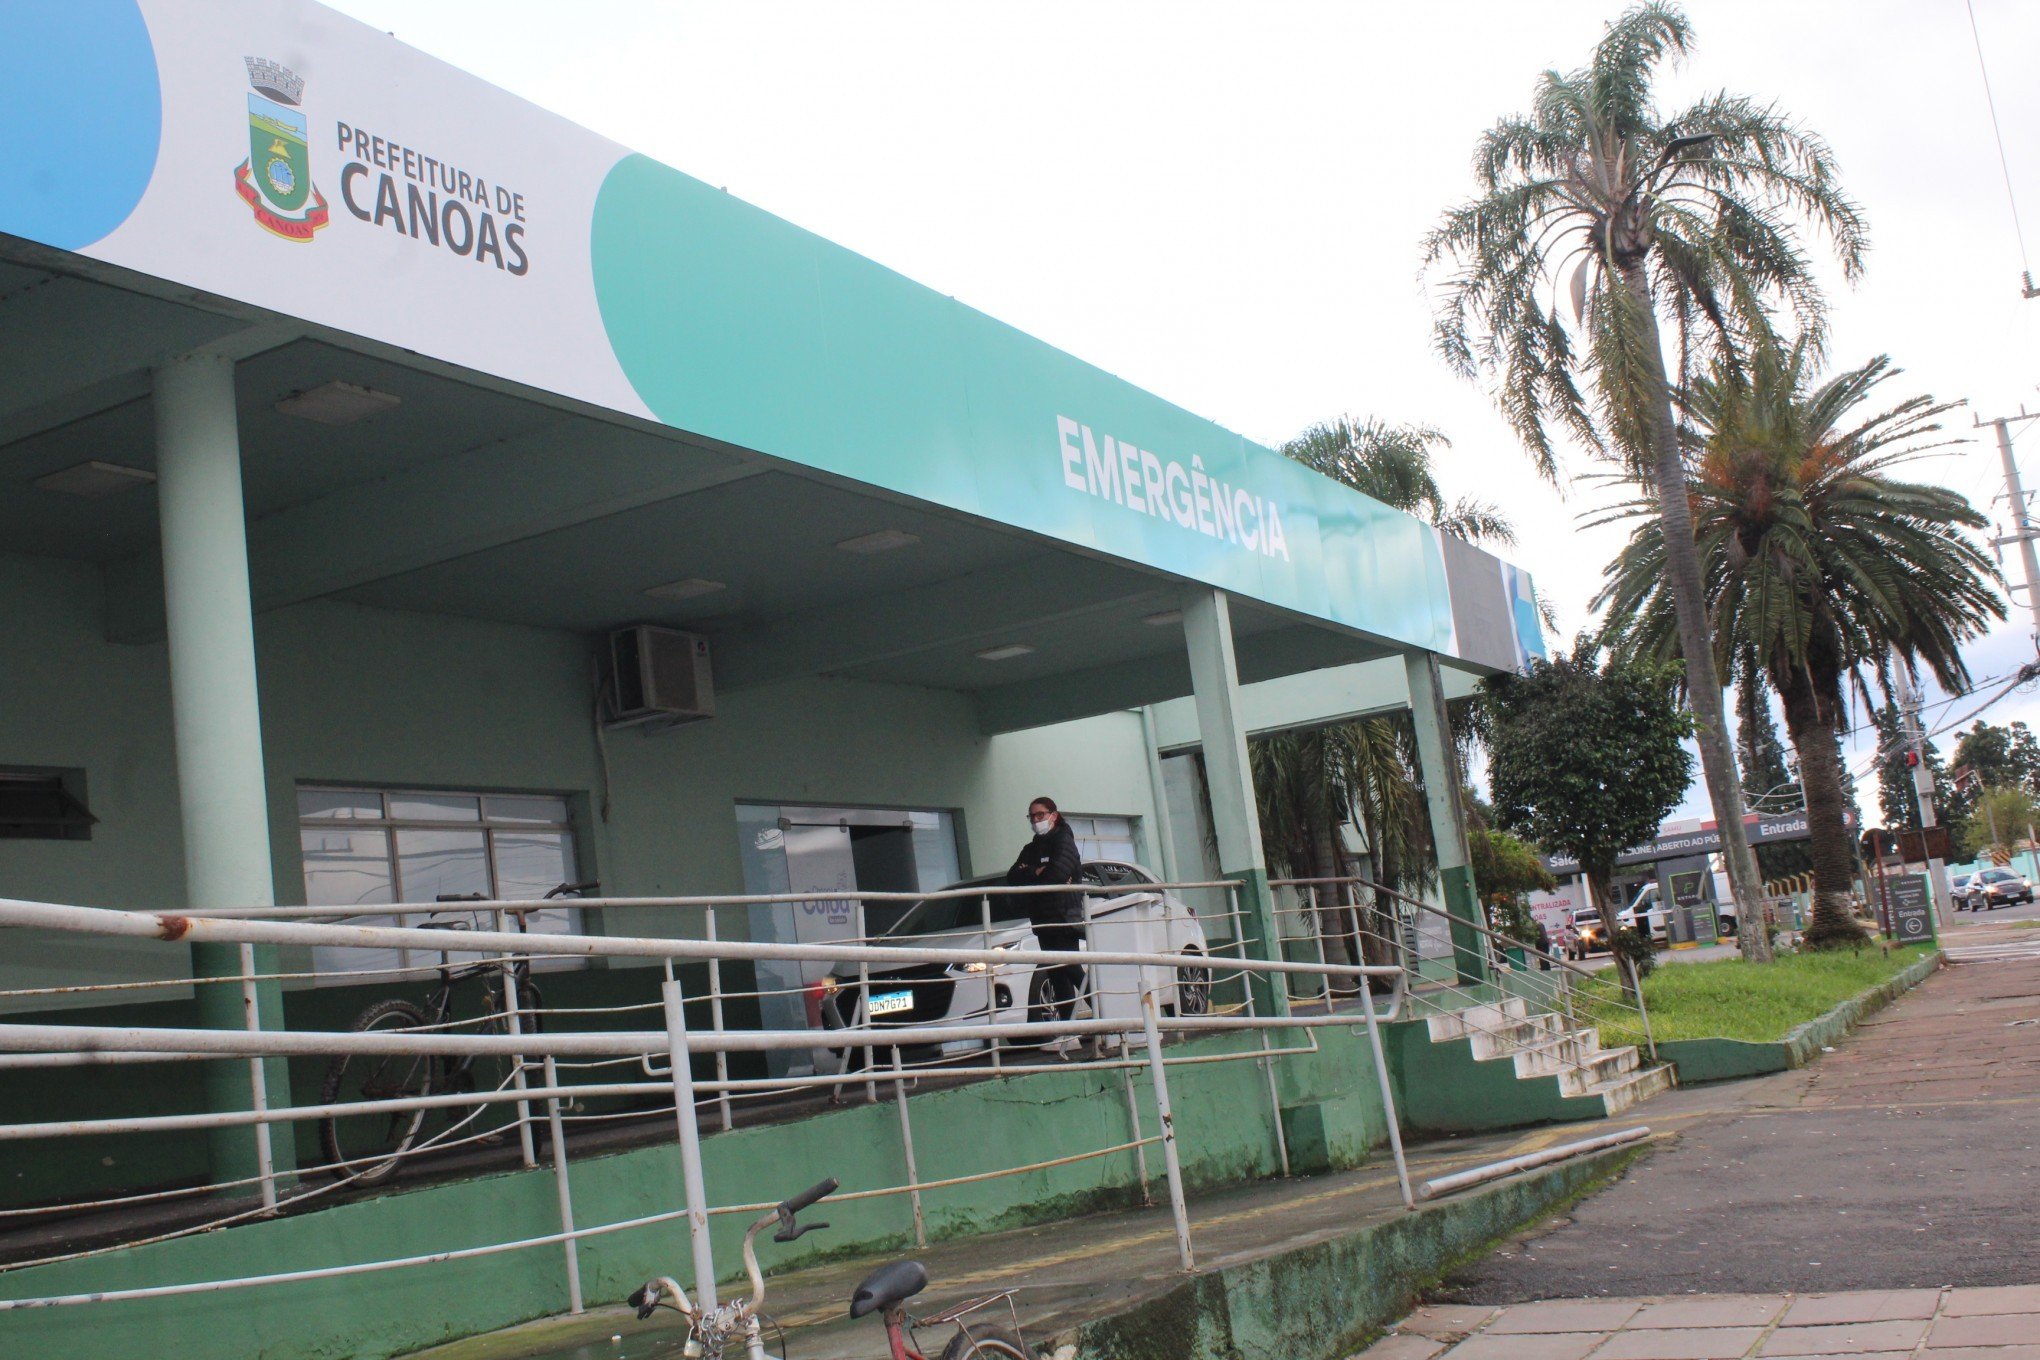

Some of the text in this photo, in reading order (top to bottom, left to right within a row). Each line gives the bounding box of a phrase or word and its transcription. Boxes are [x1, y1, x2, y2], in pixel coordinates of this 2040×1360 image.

[337, 121, 526, 223] PREFEITURA DE
[340, 161, 529, 277] CANOAS
[1056, 414, 1290, 562] EMERGÊNCIA
[1657, 840, 1691, 851] ABERTO
[1691, 837, 1704, 847] AO
[1760, 820, 1807, 836] Entrada
[1898, 909, 1926, 918] Entrada
